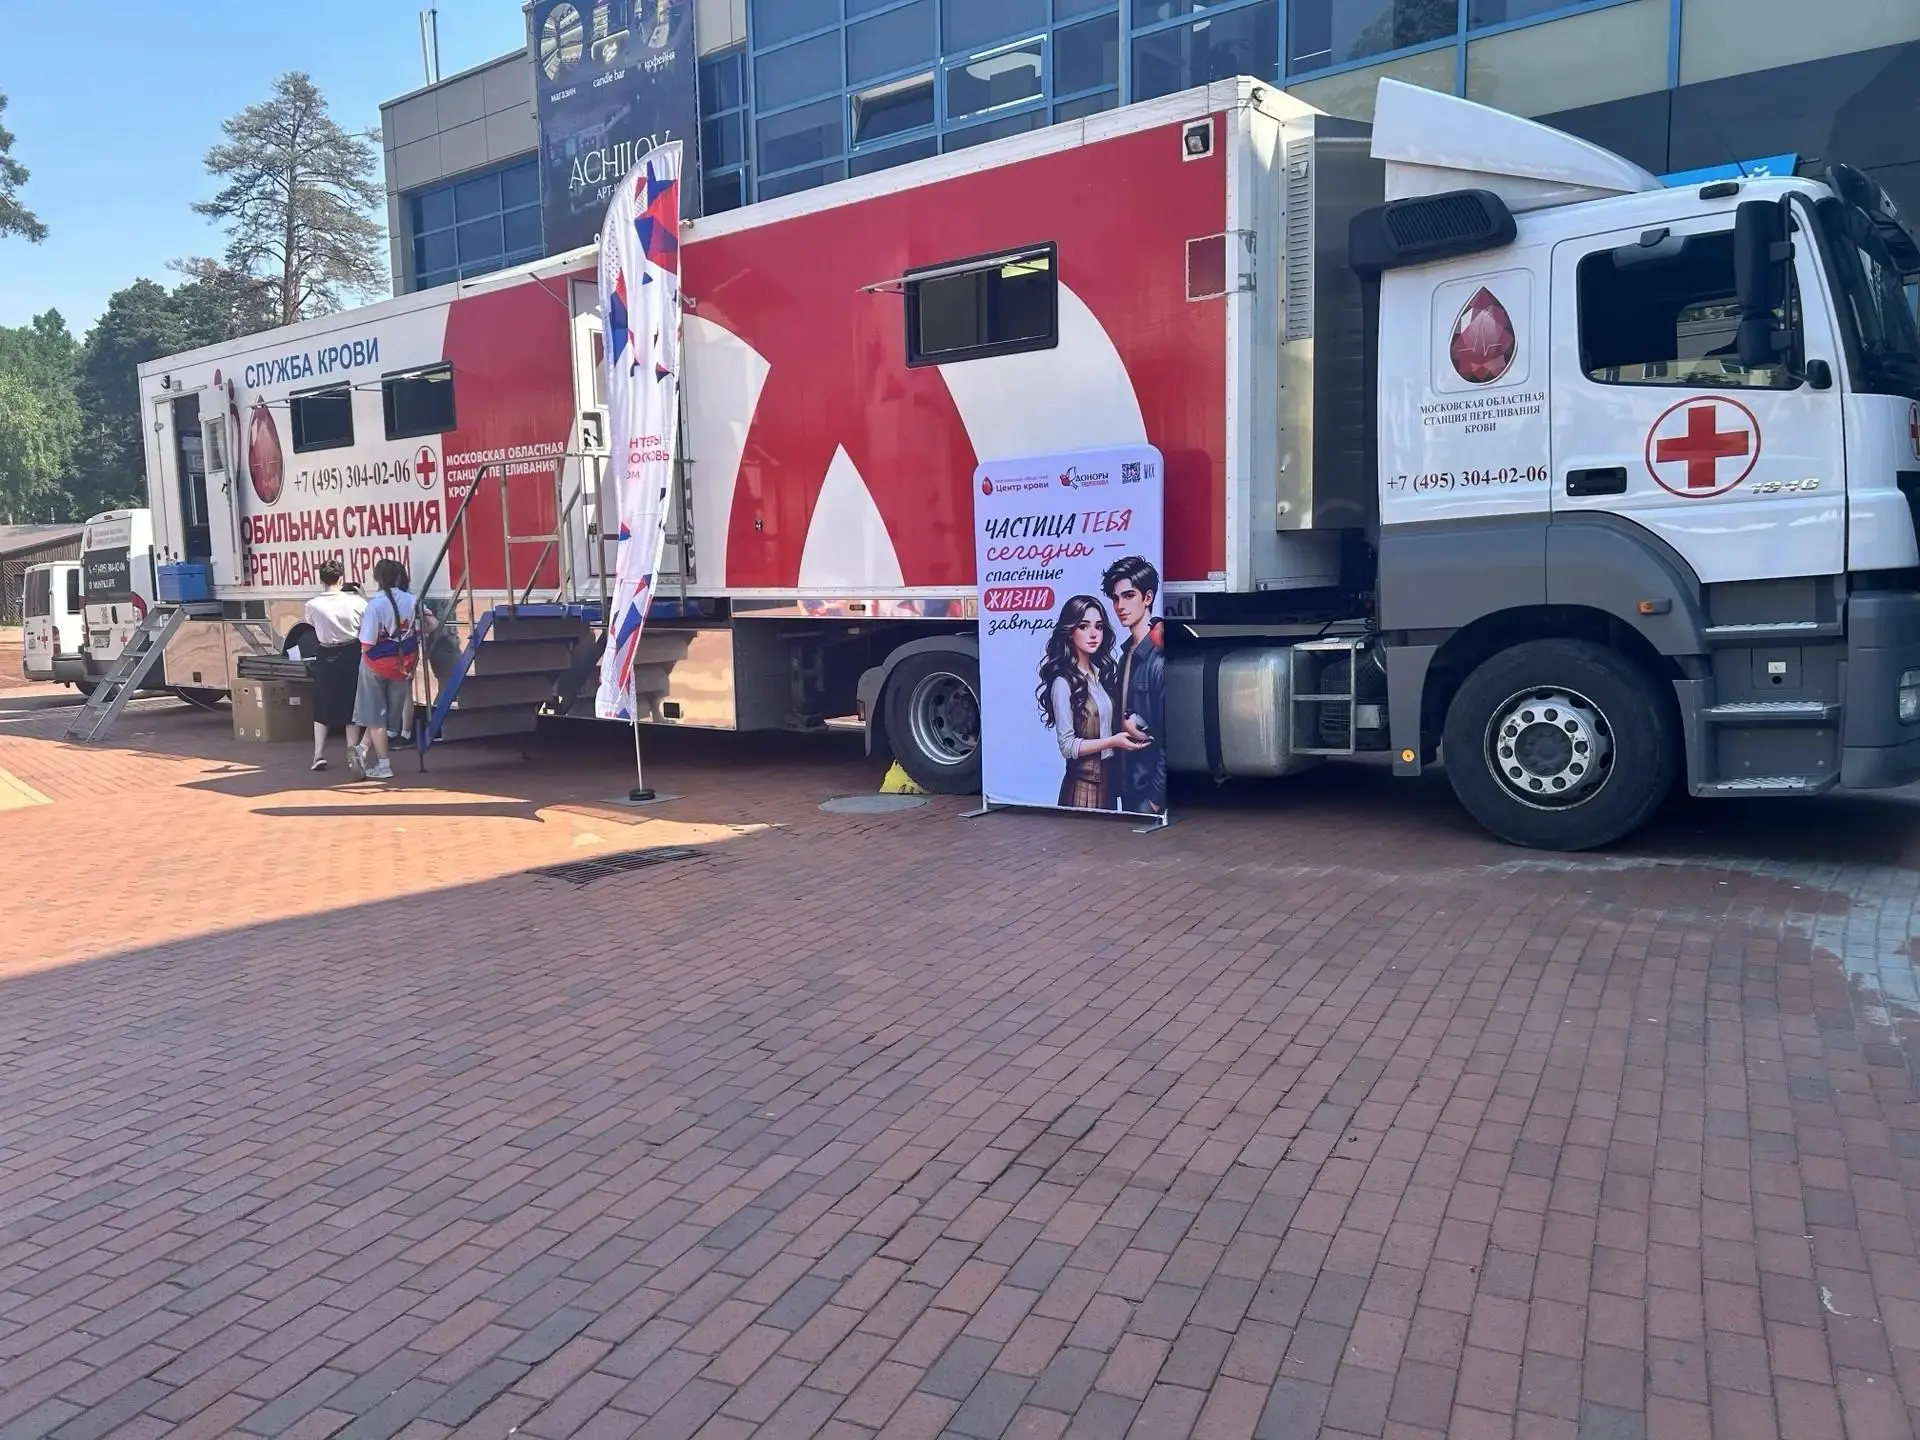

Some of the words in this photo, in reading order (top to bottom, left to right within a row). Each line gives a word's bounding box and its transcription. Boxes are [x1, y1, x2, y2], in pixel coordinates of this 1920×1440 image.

[644, 51, 675, 71] кофейня
[592, 72, 613, 88] candle
[614, 69, 626, 81] bar
[551, 87, 577, 103] магазин
[245, 353, 314, 389] СЛУЖБА
[317, 337, 380, 375] КРОВИ
[1420, 399, 1484, 414] МОСКОВСКАЯ
[1486, 392, 1545, 407] ОБЛАСТНАЯ
[1424, 411, 1468, 426] СТАНЦИЯ
[1469, 405, 1541, 421] ПЕРЕЛИВАНИЯ
[1464, 422, 1497, 434] КРОВИ
[446, 448, 506, 467] МОСКОВСКАЯ
[508, 441, 564, 459] ОБЛАСТНАЯ
[293, 471, 309, 493] +7
[312, 467, 343, 496] (495)
[346, 459, 411, 489] 304-02-06
[447, 467, 487, 482] СТАНЦЯ
[489, 460, 557, 478] ПЕЕЛИВАНИЯ
[1386, 475, 1408, 491] +7
[1413, 472, 1455, 493] (495)
[1460, 464, 1548, 487] 304-02-06
[995, 484, 1021, 493] Центр
[1023, 482, 1049, 491] крови
[241, 507, 339, 545] ОБИЛЬНАЯ
[343, 500, 442, 541] СТАНЦИЯ
[985, 513, 1077, 540] ЧАСТИЦА
[1081, 508, 1133, 534] ТЕБЯ
[987, 542, 1094, 568] сегодня
[985, 566, 1064, 583] спасённые
[986, 588, 1050, 609] ЖИЗНИ
[988, 613, 1057, 636] завтра
